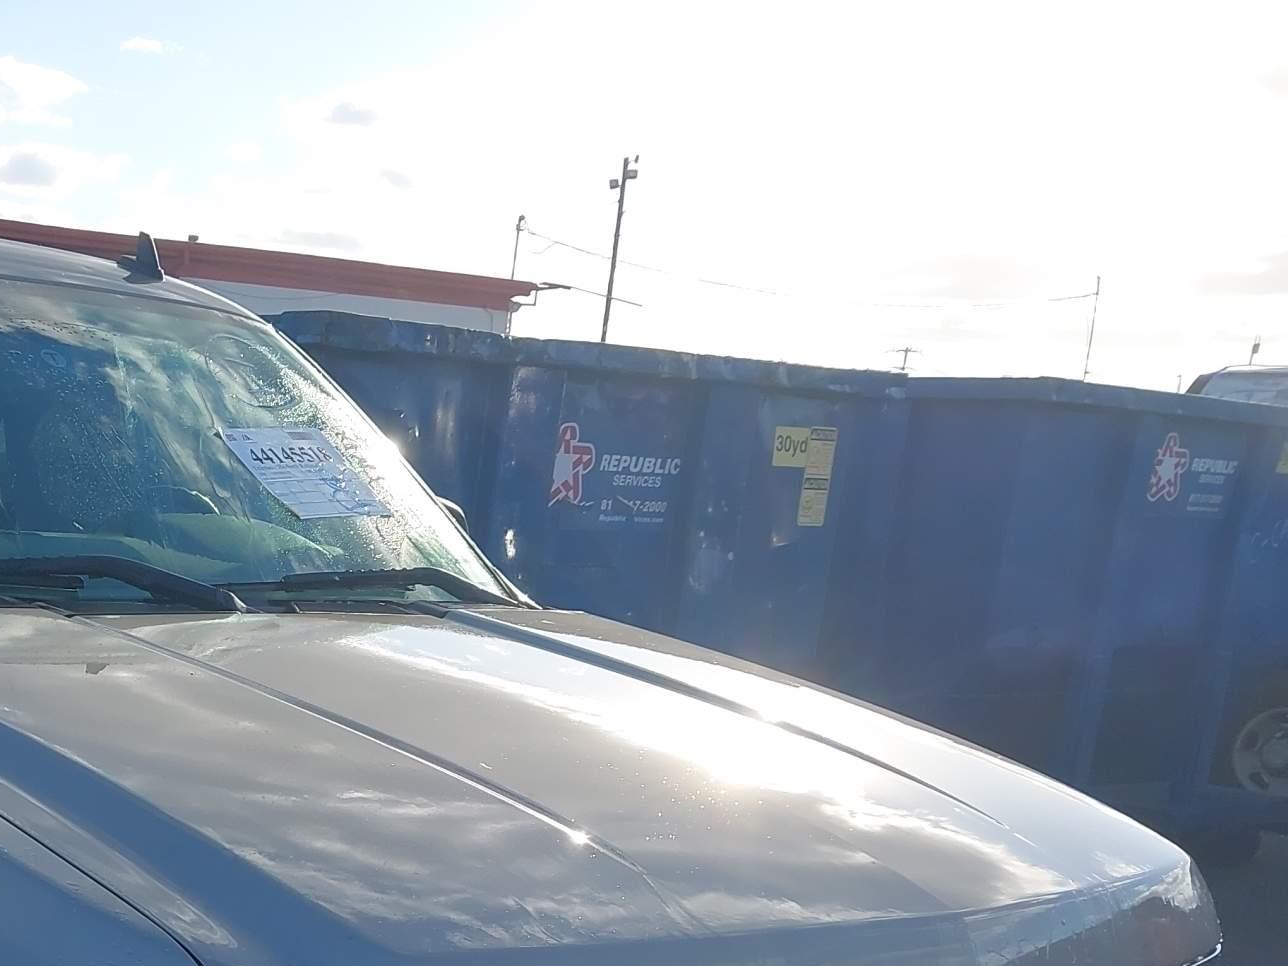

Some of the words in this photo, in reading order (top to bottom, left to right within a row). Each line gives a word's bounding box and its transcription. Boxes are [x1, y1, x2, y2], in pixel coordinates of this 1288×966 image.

[249, 446, 333, 465] 44145518
[776, 434, 808, 457] 30yd
[600, 454, 681, 475] REPUBLIC
[612, 474, 661, 488] SERVICES
